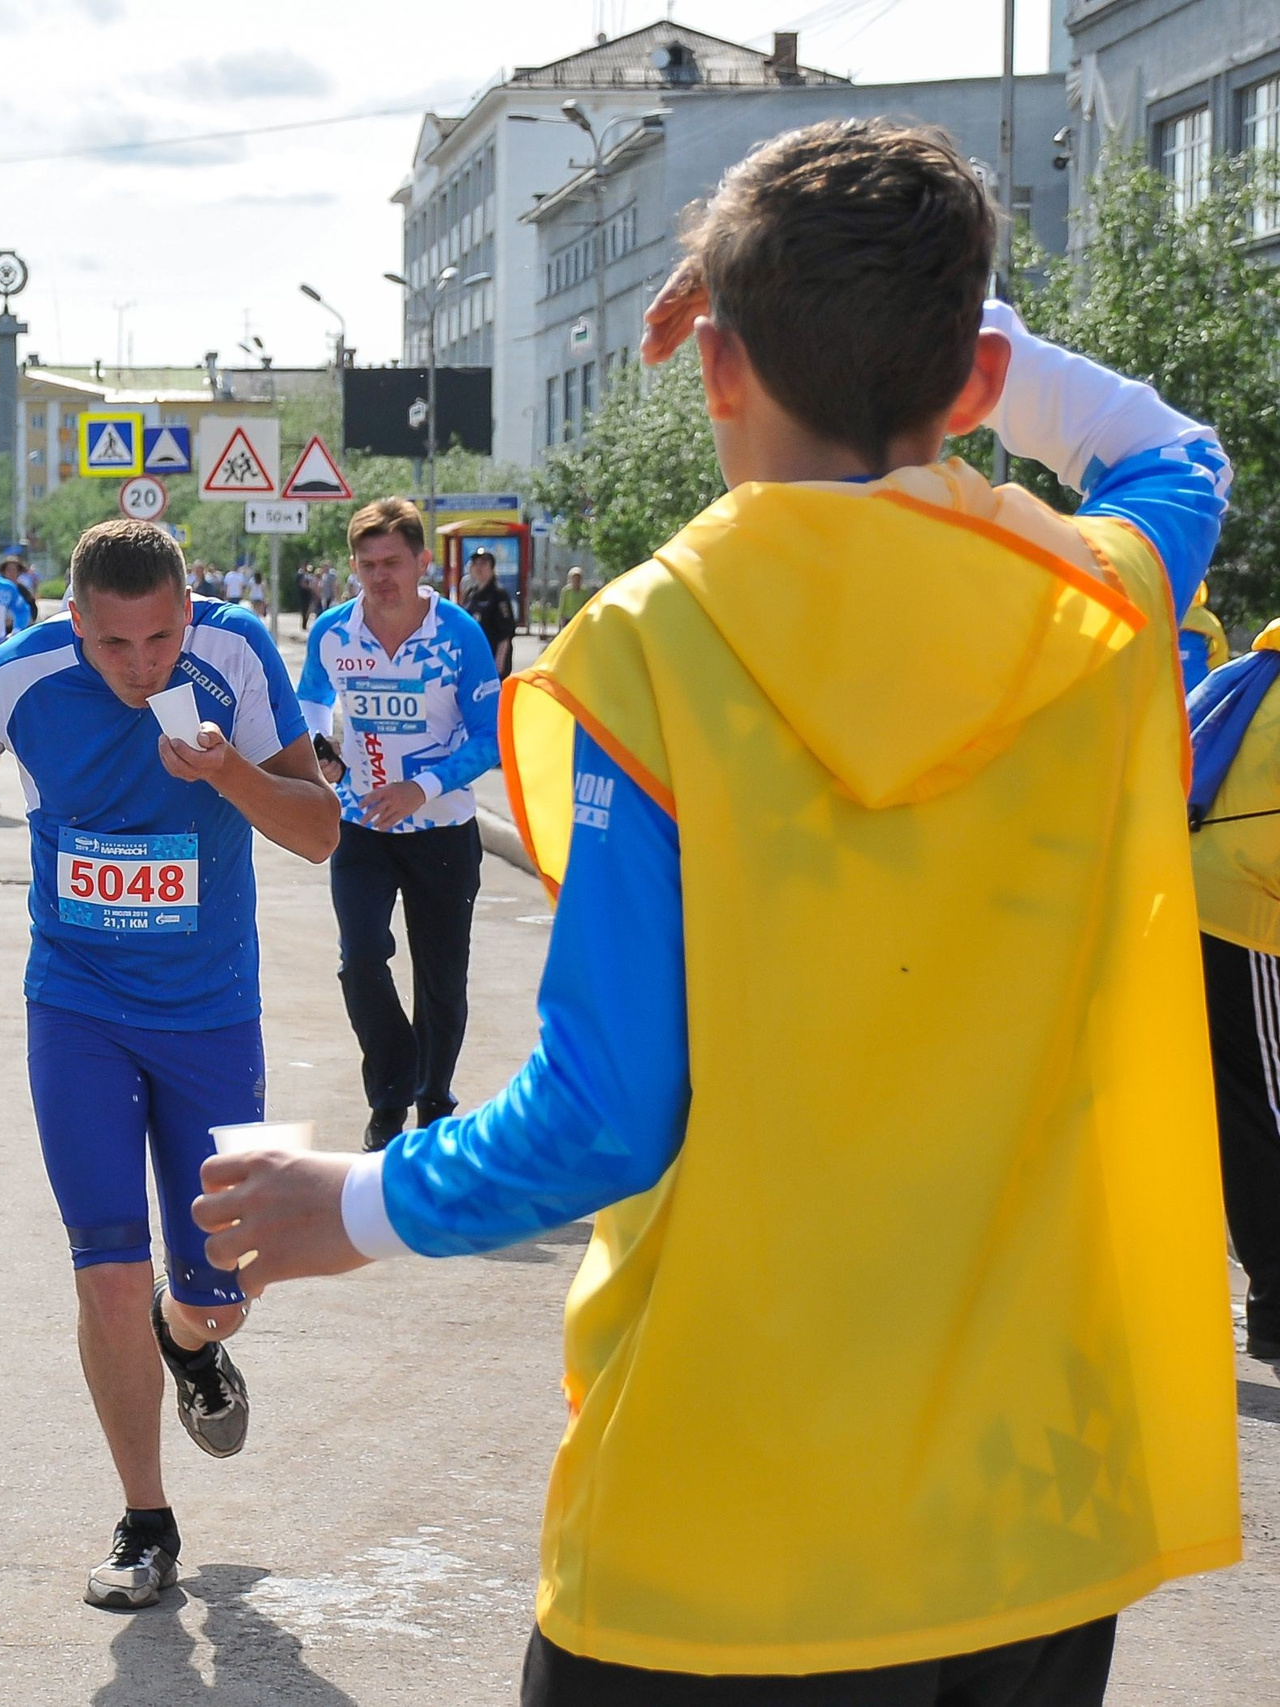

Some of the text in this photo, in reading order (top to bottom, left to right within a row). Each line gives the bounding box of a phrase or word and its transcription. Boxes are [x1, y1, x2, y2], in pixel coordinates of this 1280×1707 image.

[130, 489, 157, 508] 20
[336, 658, 376, 671] 2019
[353, 694, 418, 717] 3100
[70, 859, 185, 903] 5048
[103, 917, 126, 929] 21,1
[129, 918, 148, 928] КМ
